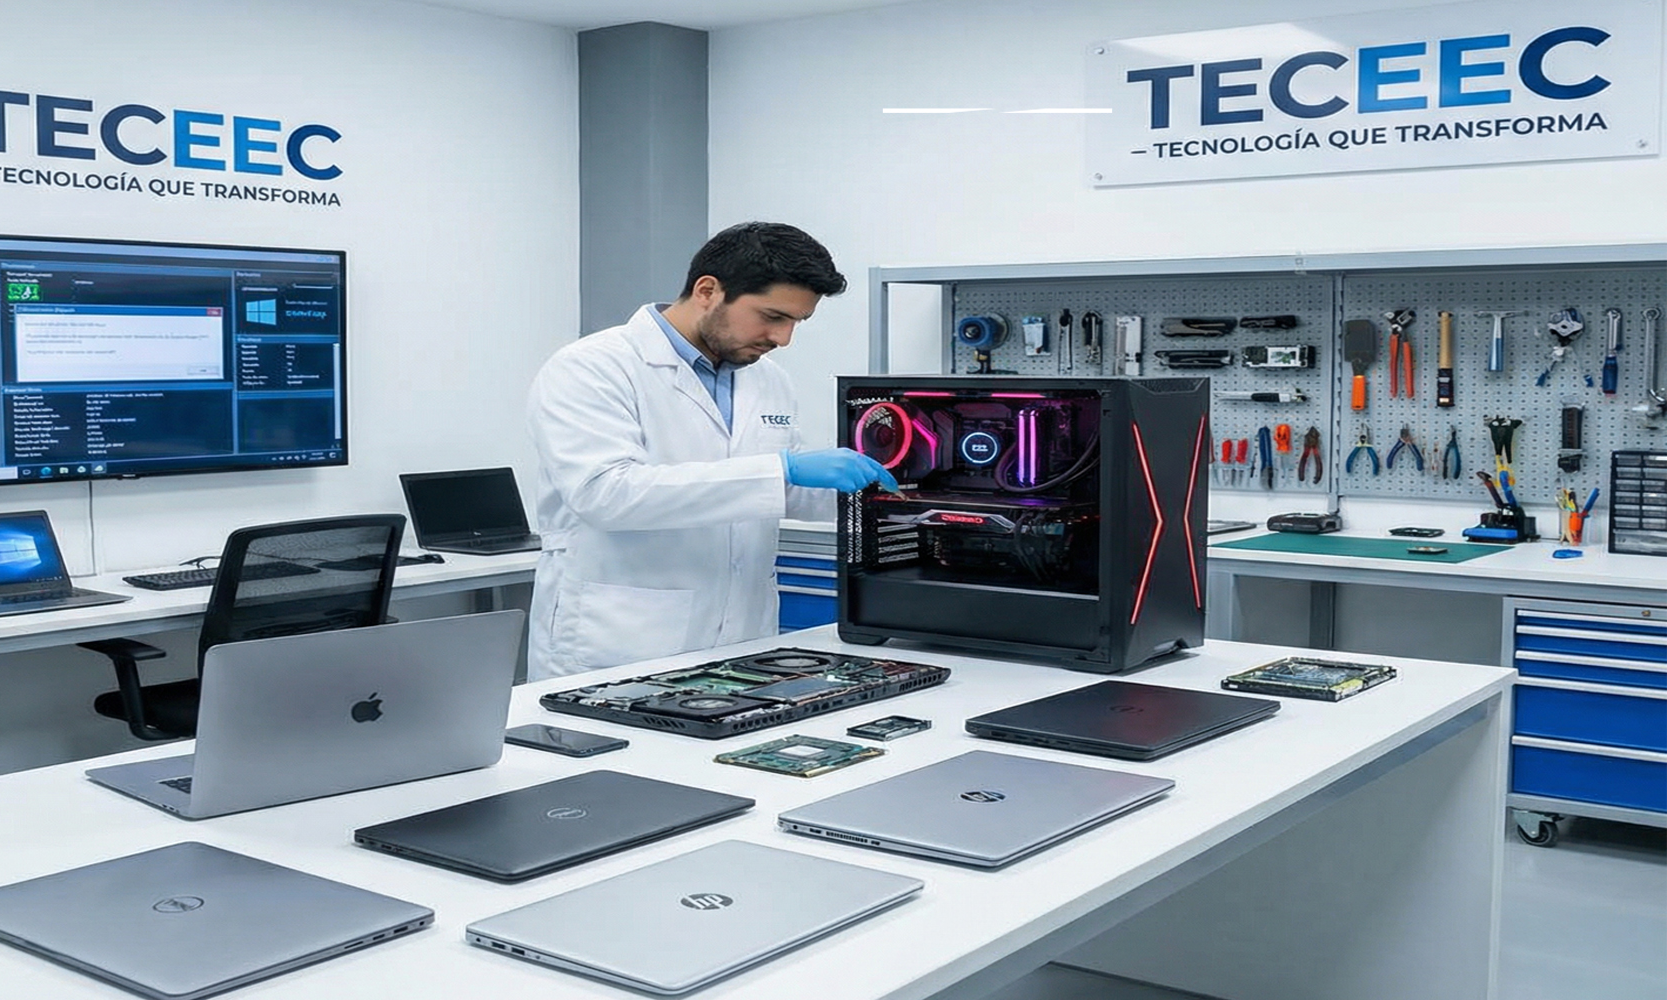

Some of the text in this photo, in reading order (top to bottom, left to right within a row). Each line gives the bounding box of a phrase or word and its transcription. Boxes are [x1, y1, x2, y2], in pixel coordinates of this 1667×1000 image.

[1127, 26, 1611, 130] TECEEC
[1153, 127, 1320, 158] TECNOLOGÍA
[1328, 126, 1387, 149] QUE
[1395, 112, 1607, 142] TRANSFORMA
[148, 178, 195, 196] QUE
[201, 182, 341, 207] TRANSFORMA
